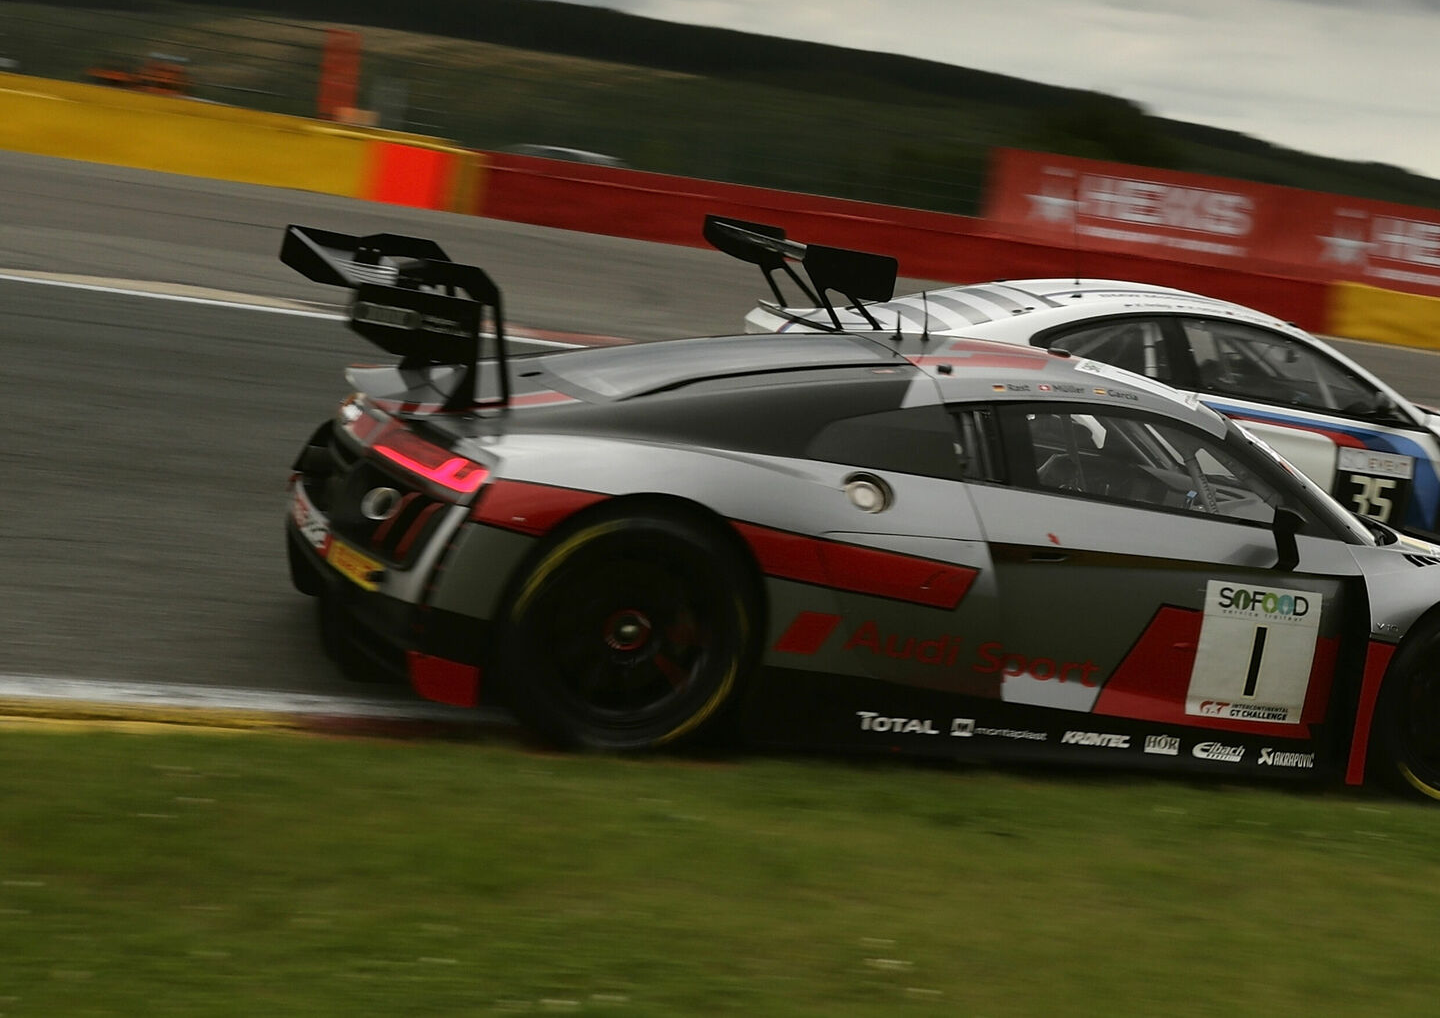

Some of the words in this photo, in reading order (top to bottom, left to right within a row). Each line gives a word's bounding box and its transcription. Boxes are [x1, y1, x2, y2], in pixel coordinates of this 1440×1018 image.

[1350, 475, 1397, 523] 35
[1218, 587, 1309, 617] SOFOOD
[842, 620, 965, 668] Audi
[971, 641, 1101, 688] Sport
[1242, 709, 1288, 721] CHALLENGE
[1191, 742, 1246, 762] Eibach
